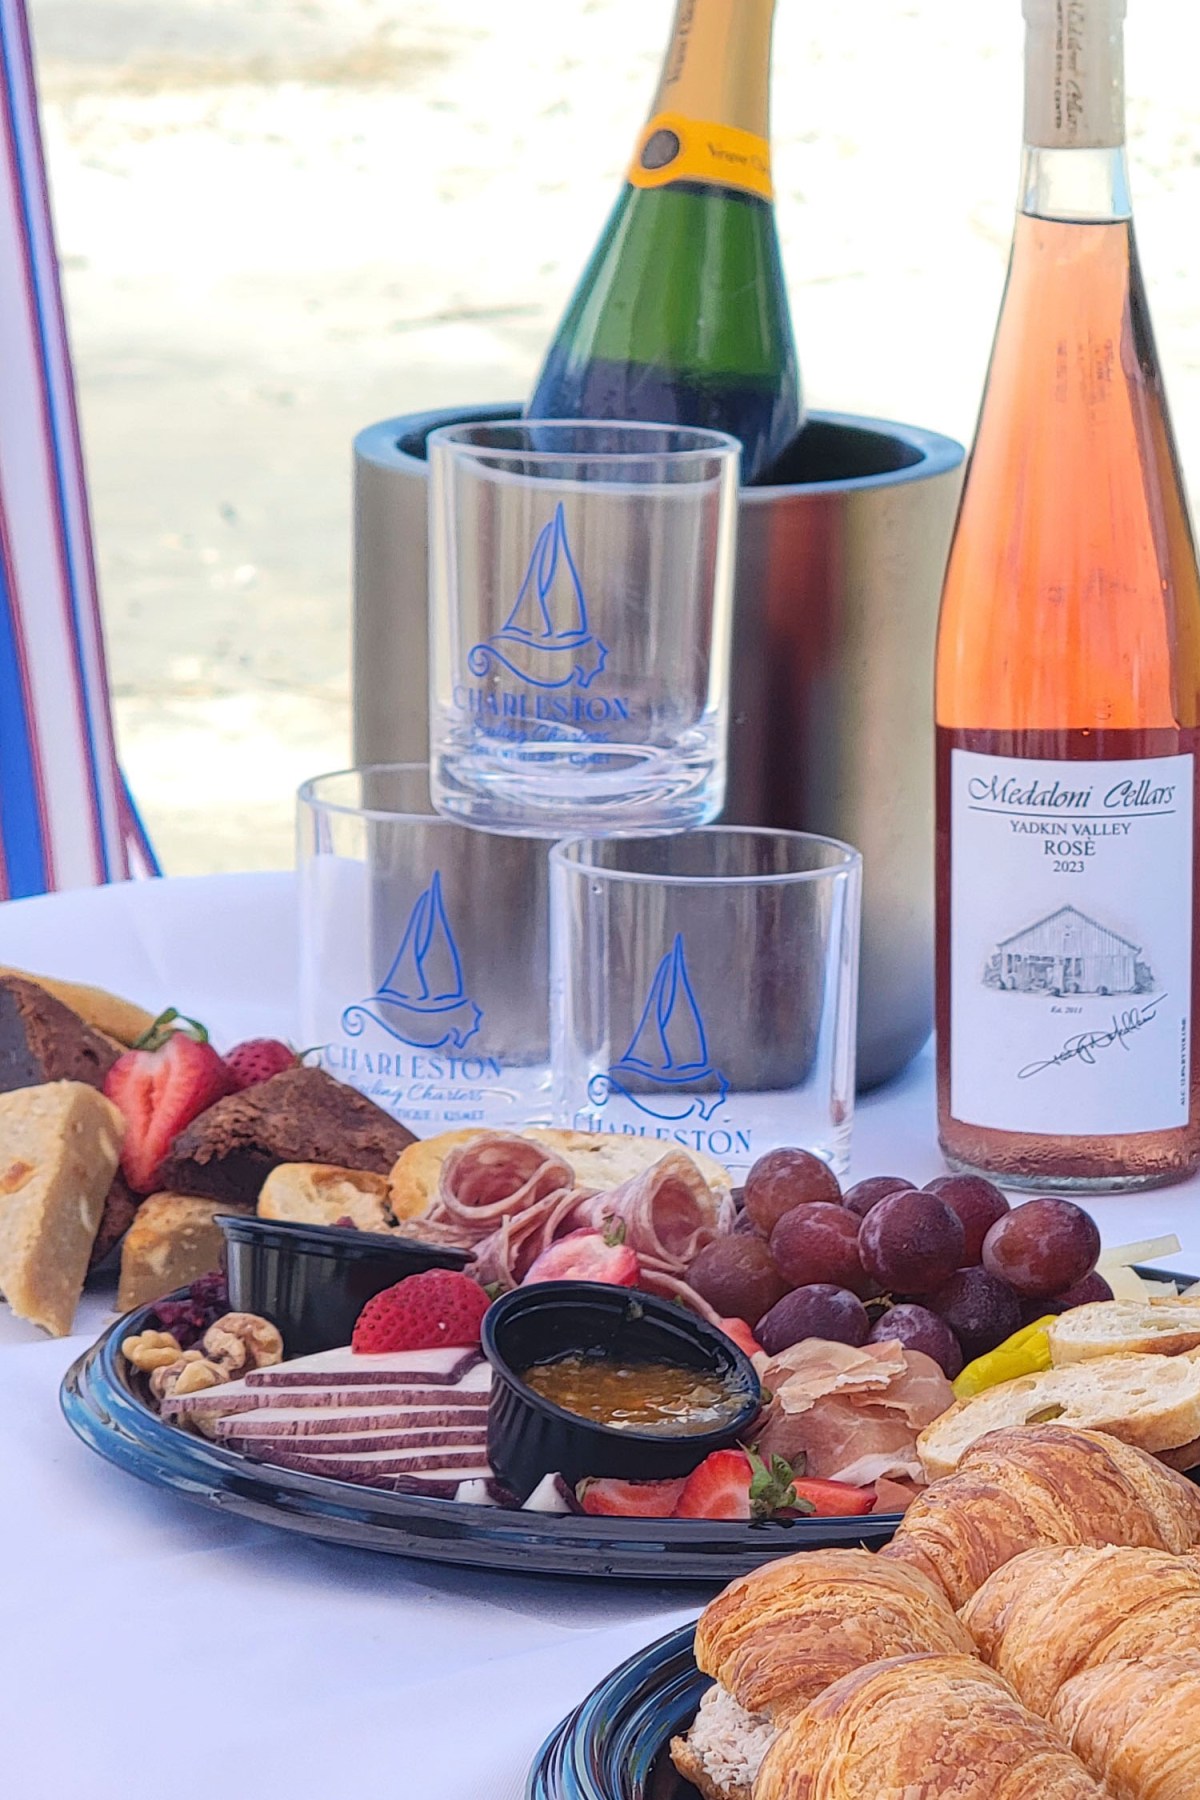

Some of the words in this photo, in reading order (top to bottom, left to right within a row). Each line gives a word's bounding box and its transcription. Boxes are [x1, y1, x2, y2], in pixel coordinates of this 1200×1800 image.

[453, 685, 630, 722] CHARLESTON
[968, 775, 1093, 809] Medaloni
[1103, 779, 1176, 809] Cellars
[1009, 820, 1068, 836] YADKIN
[1072, 822, 1132, 836] VALLEY
[1052, 860, 1085, 873] 2023
[324, 1043, 502, 1081] CHARLESTON
[407, 1083, 482, 1102] Charters
